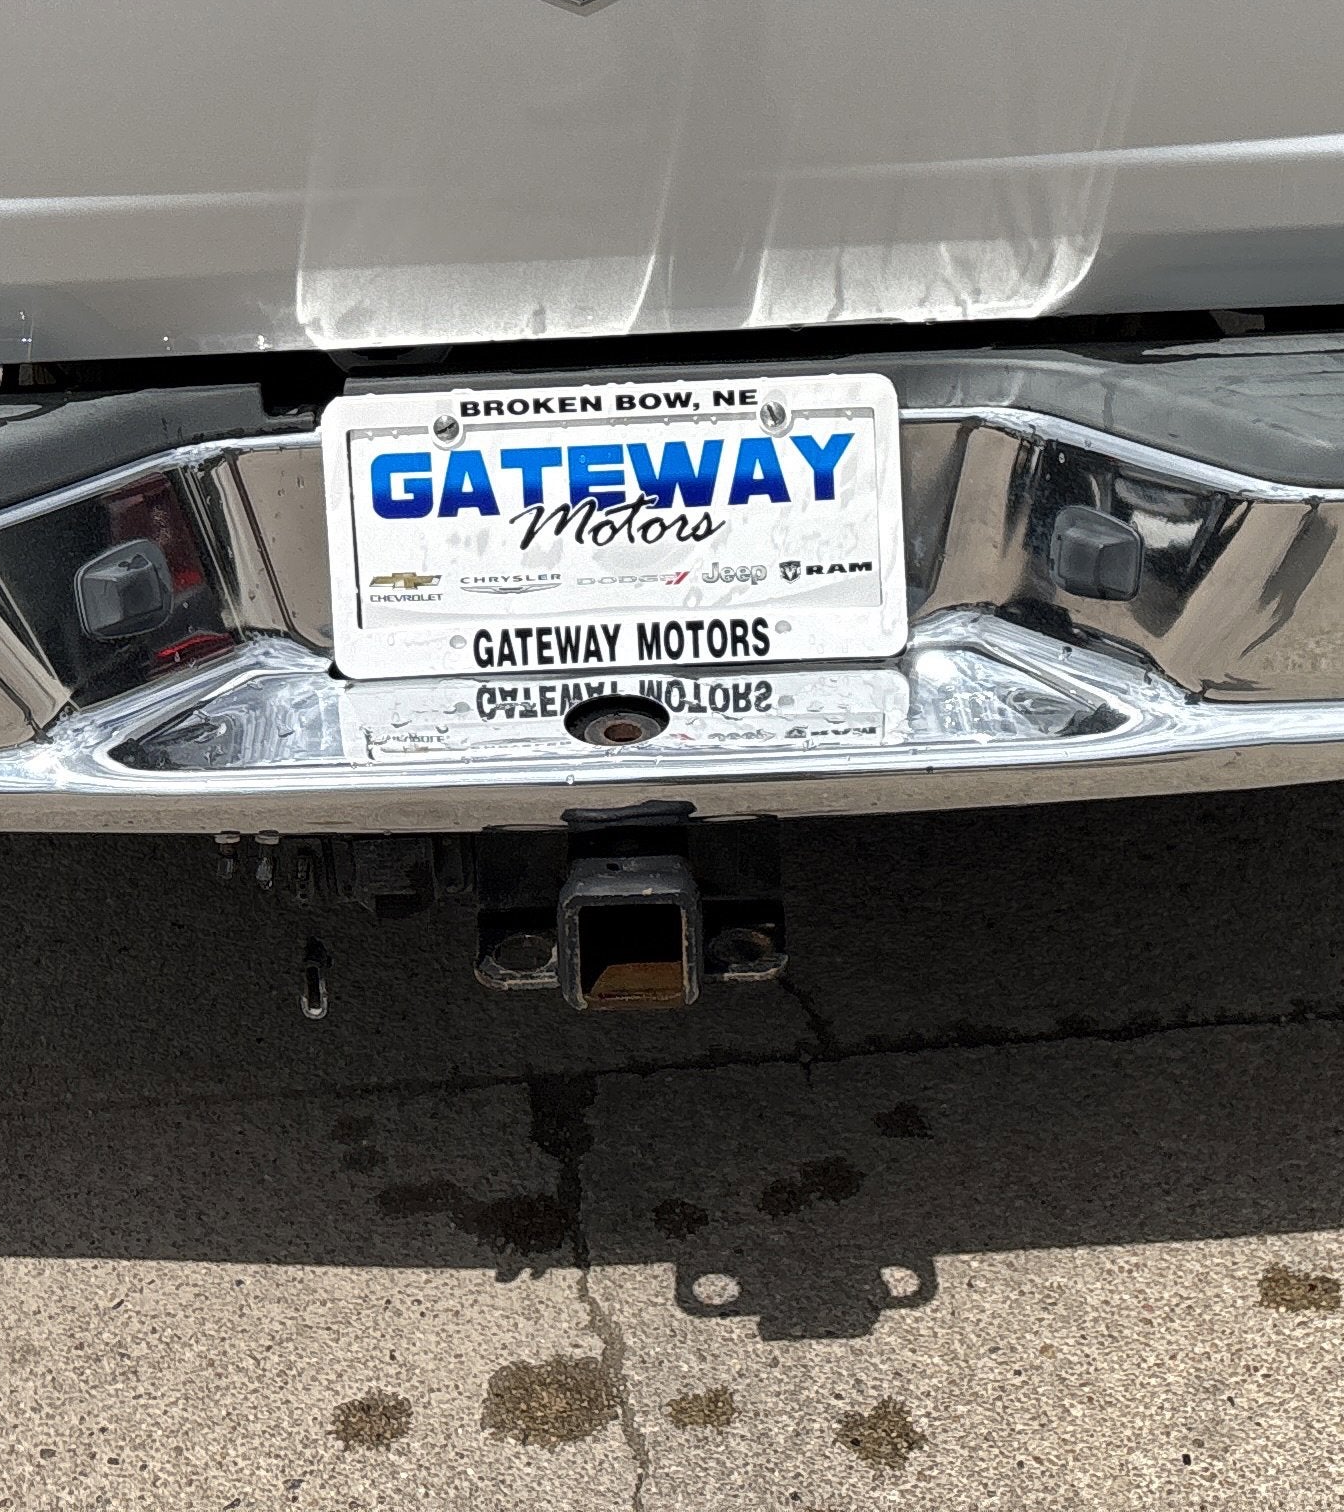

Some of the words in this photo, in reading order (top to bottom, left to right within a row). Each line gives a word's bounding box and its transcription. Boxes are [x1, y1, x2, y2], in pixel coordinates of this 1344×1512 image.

[459, 395, 602, 418] BROKEN
[615, 391, 699, 412] BOW,
[713, 389, 758, 407] NE
[370, 432, 854, 520] GATEWAY
[509, 493, 726, 550] Motors
[460, 573, 562, 584] CHRYSLER
[702, 562, 767, 586] Jeep
[806, 561, 873, 575] RAM
[370, 593, 443, 603] CHEVROLET
[473, 624, 621, 668] GATEWAY
[636, 617, 770, 661] MOTORS
